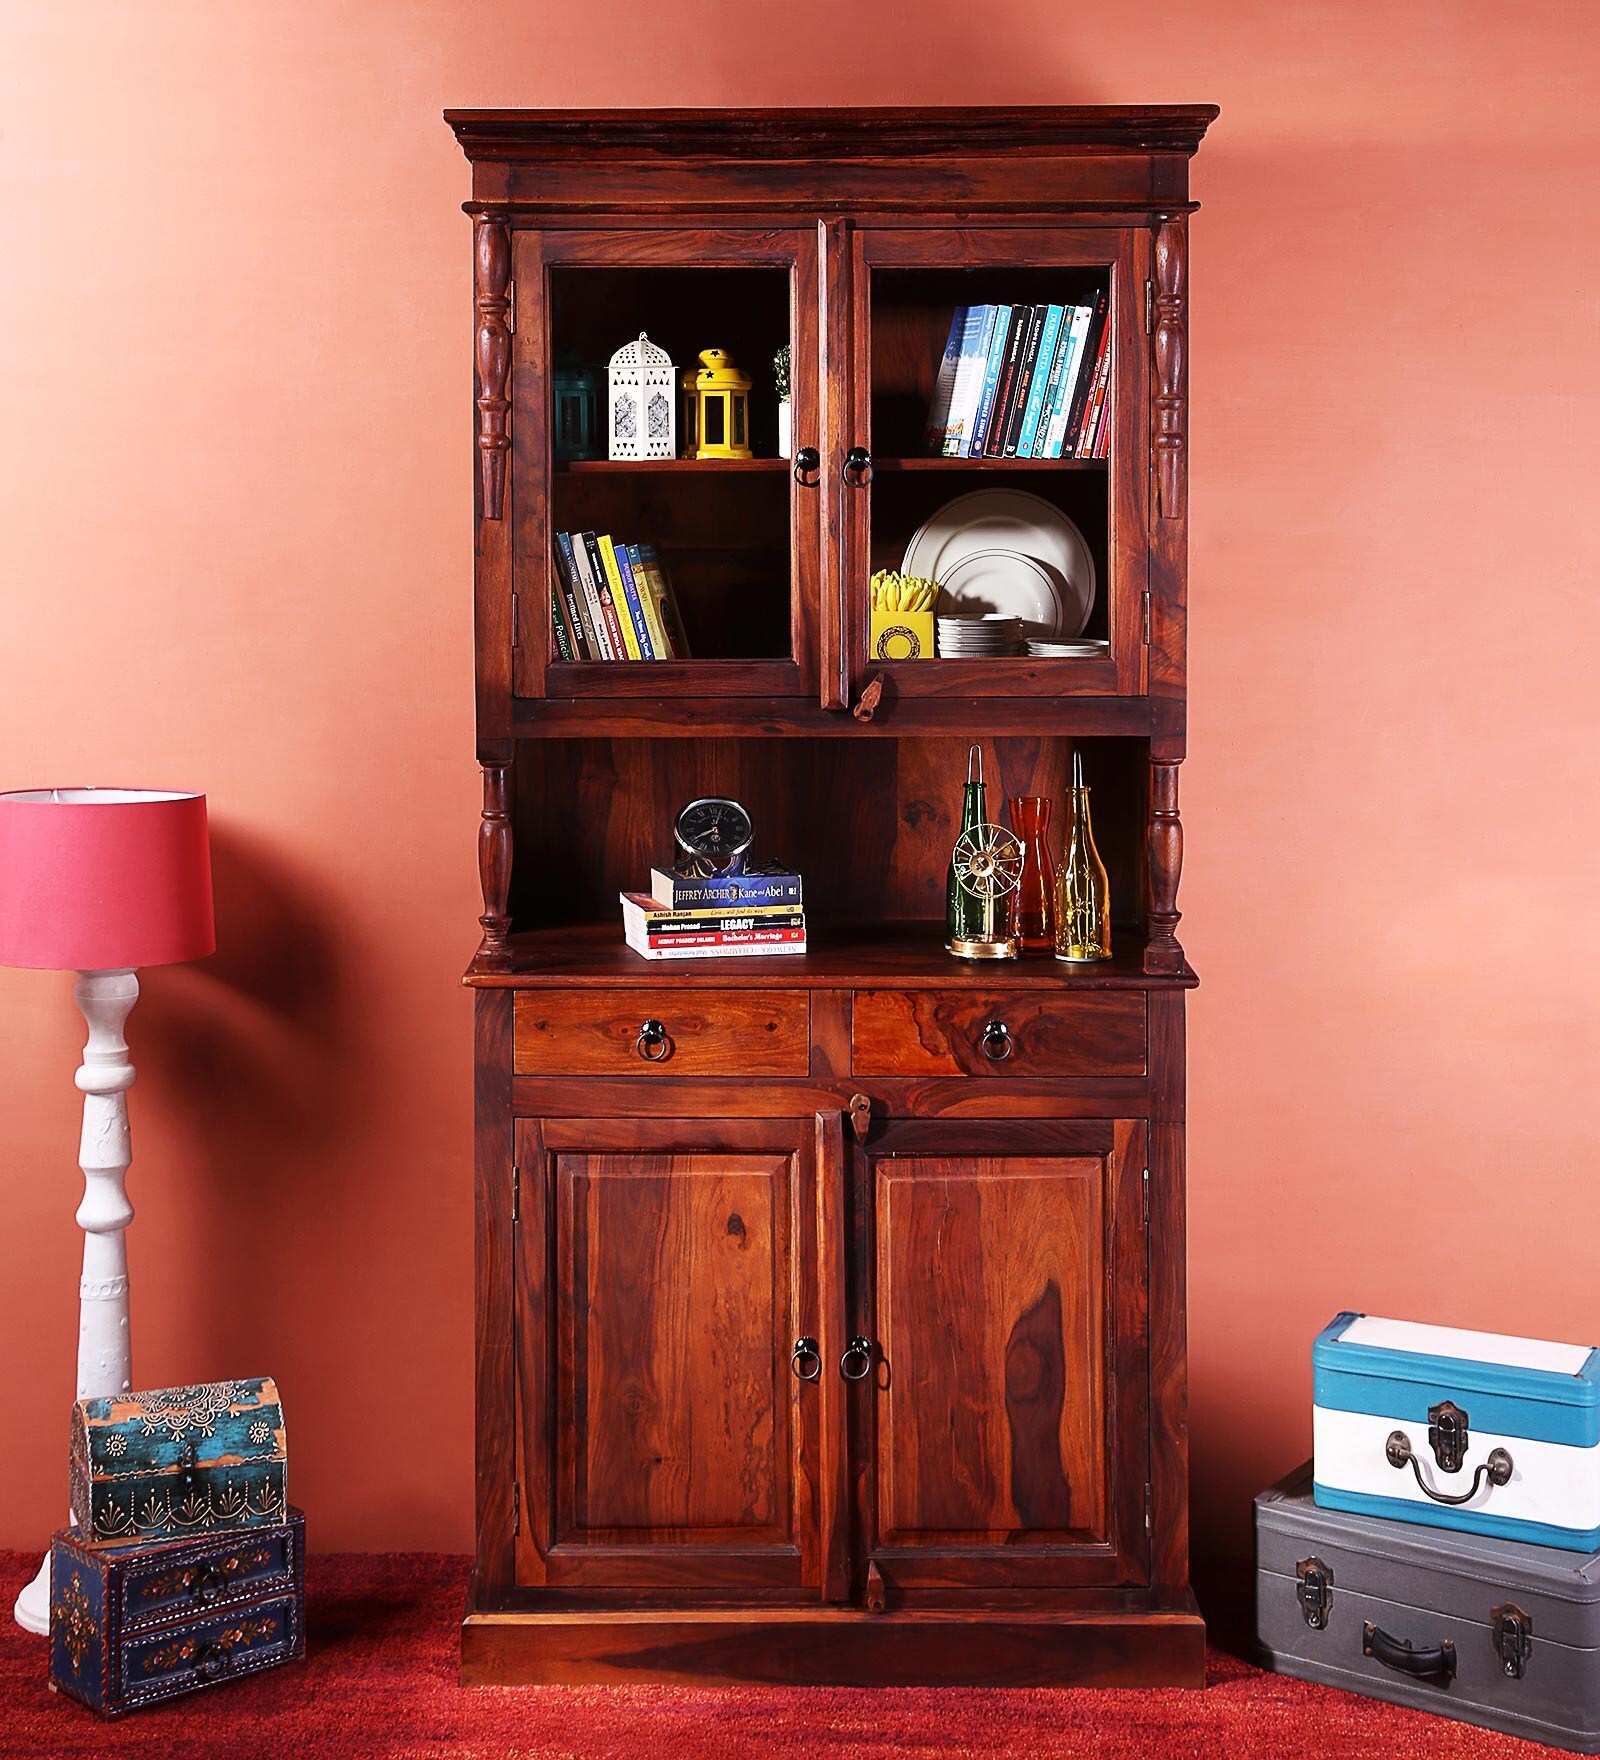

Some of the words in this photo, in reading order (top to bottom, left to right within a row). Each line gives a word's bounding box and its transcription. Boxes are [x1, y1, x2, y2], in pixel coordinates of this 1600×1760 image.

[1015, 319, 1023, 339] RASHMI
[1033, 320, 1041, 340] RASHMI
[1045, 313, 1057, 344] DURJOY
[1010, 341, 1019, 362] BANSAL
[1028, 341, 1036, 362] BANSAL
[1040, 345, 1050, 370] DATTA
[981, 388, 991, 417] RAVINDER
[977, 418, 985, 437] SINGH
[567, 593, 579, 622] Destined
[574, 622, 583, 639] Lives
[607, 609, 616, 631] DESTINY
[675, 890, 702, 903] JEFFREY
[703, 888, 730, 900] ARCHER
[739, 887, 757, 898] Kane
[765, 885, 783, 896] Abel
[720, 919, 754, 930] LEGACY
[710, 946, 754, 955] CHAMPIONS
